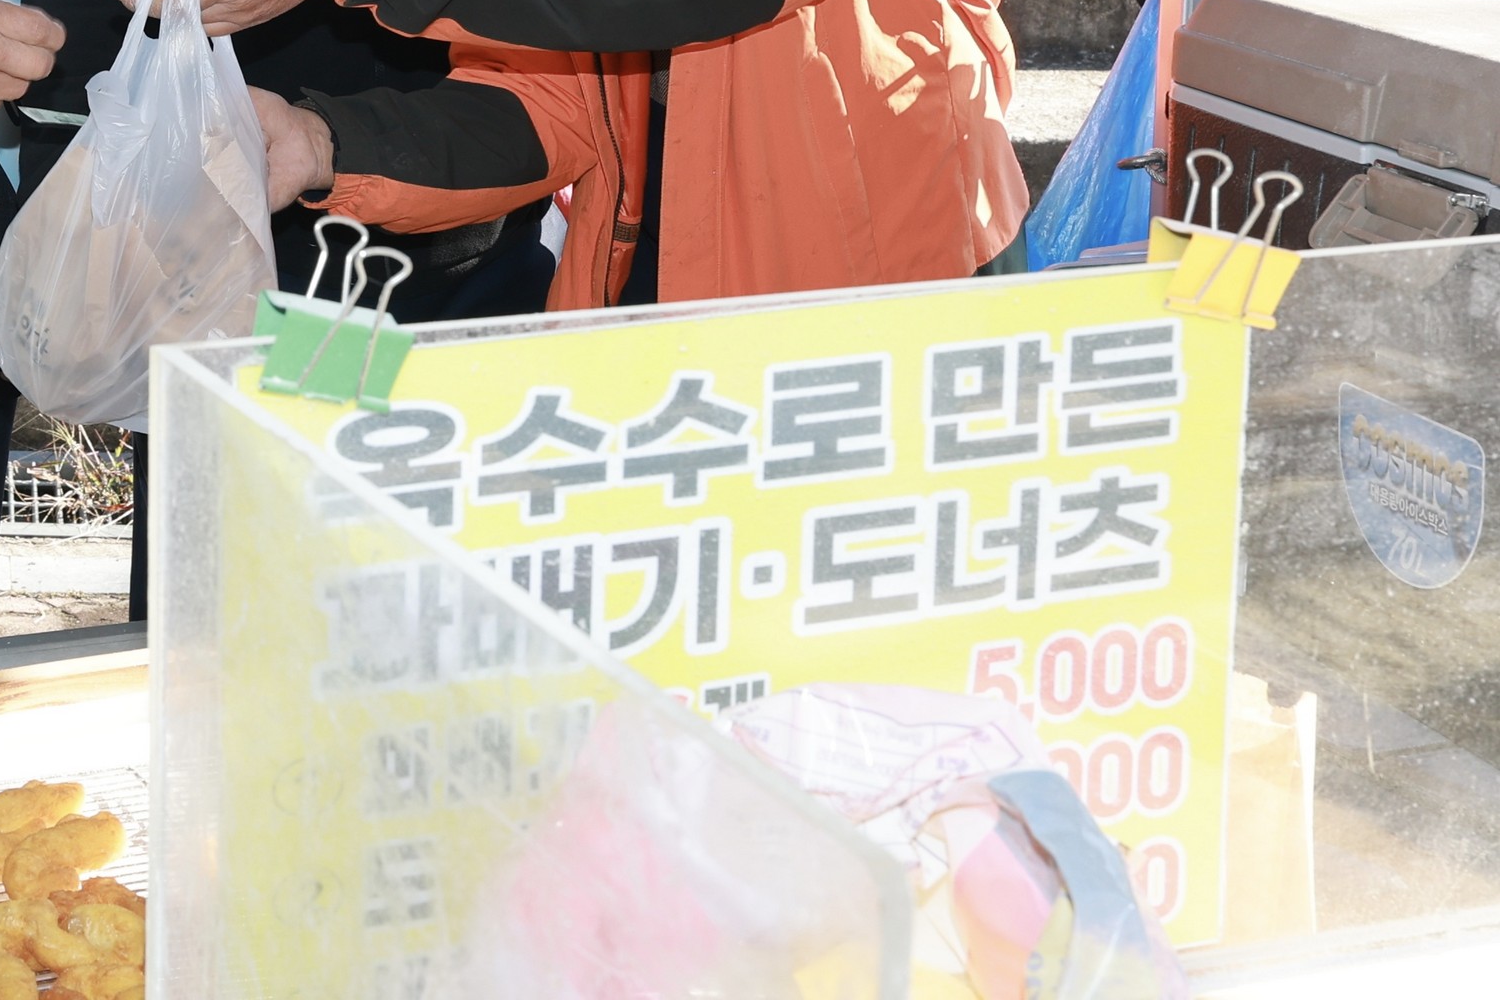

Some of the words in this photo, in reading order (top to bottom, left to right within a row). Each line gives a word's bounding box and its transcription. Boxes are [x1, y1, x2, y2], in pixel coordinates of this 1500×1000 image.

[316, 356, 889, 528] 옥수수로
[929, 322, 1181, 468] 만든
[1369, 481, 1449, 536] 대용량아이스박스
[972, 626, 1190, 719] 5,000
